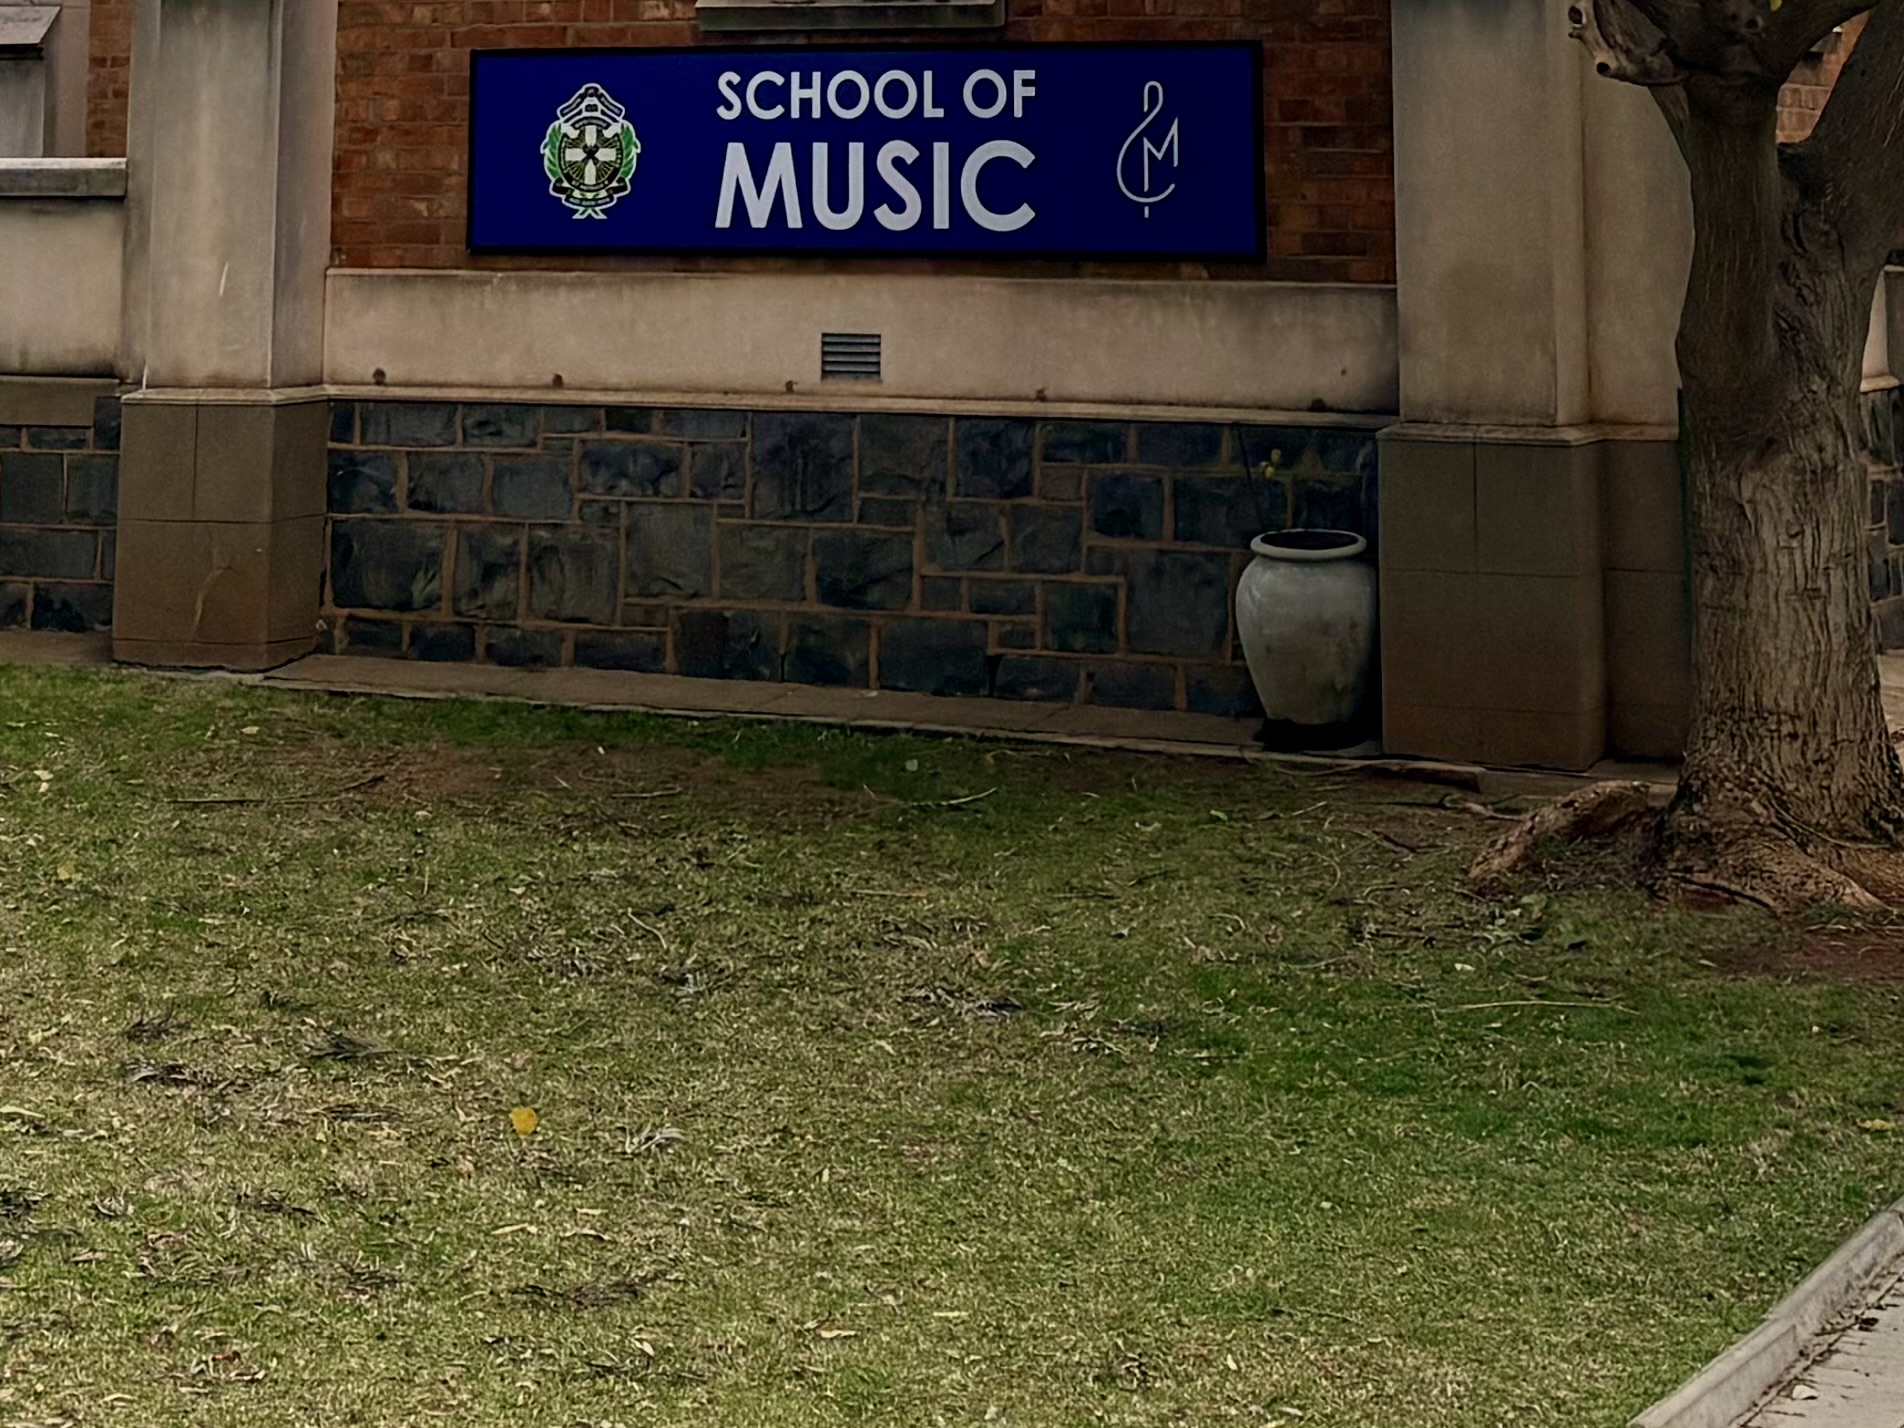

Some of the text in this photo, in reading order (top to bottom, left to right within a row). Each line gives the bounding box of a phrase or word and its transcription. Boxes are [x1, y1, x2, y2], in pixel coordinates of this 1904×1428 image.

[716, 68, 1036, 121] SCHOOL OF
[714, 139, 1036, 232] MUSIC
